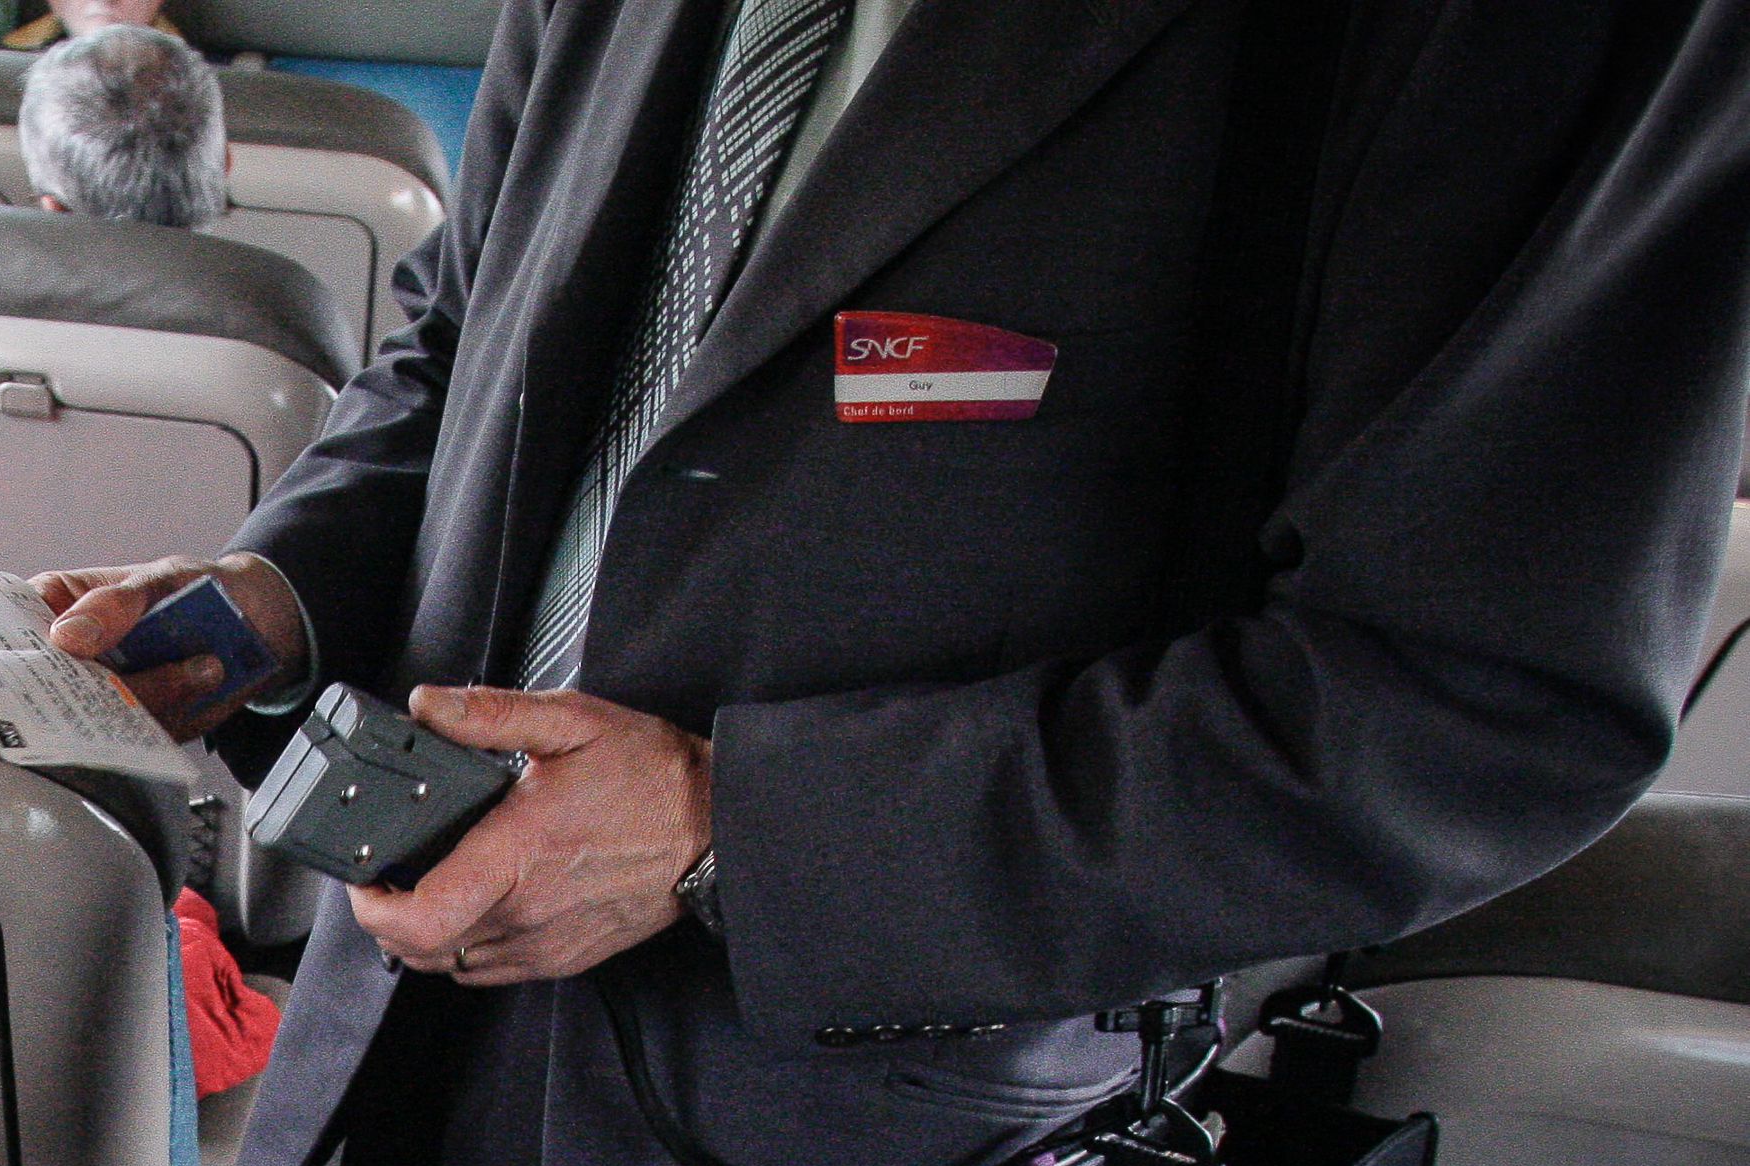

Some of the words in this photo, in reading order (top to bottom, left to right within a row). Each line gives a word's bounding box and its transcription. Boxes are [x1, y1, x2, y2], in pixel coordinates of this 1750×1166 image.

[848, 337, 928, 360] SNCF
[843, 406, 868, 417] Chef
[871, 406, 885, 416] de
[888, 406, 914, 416] bord
